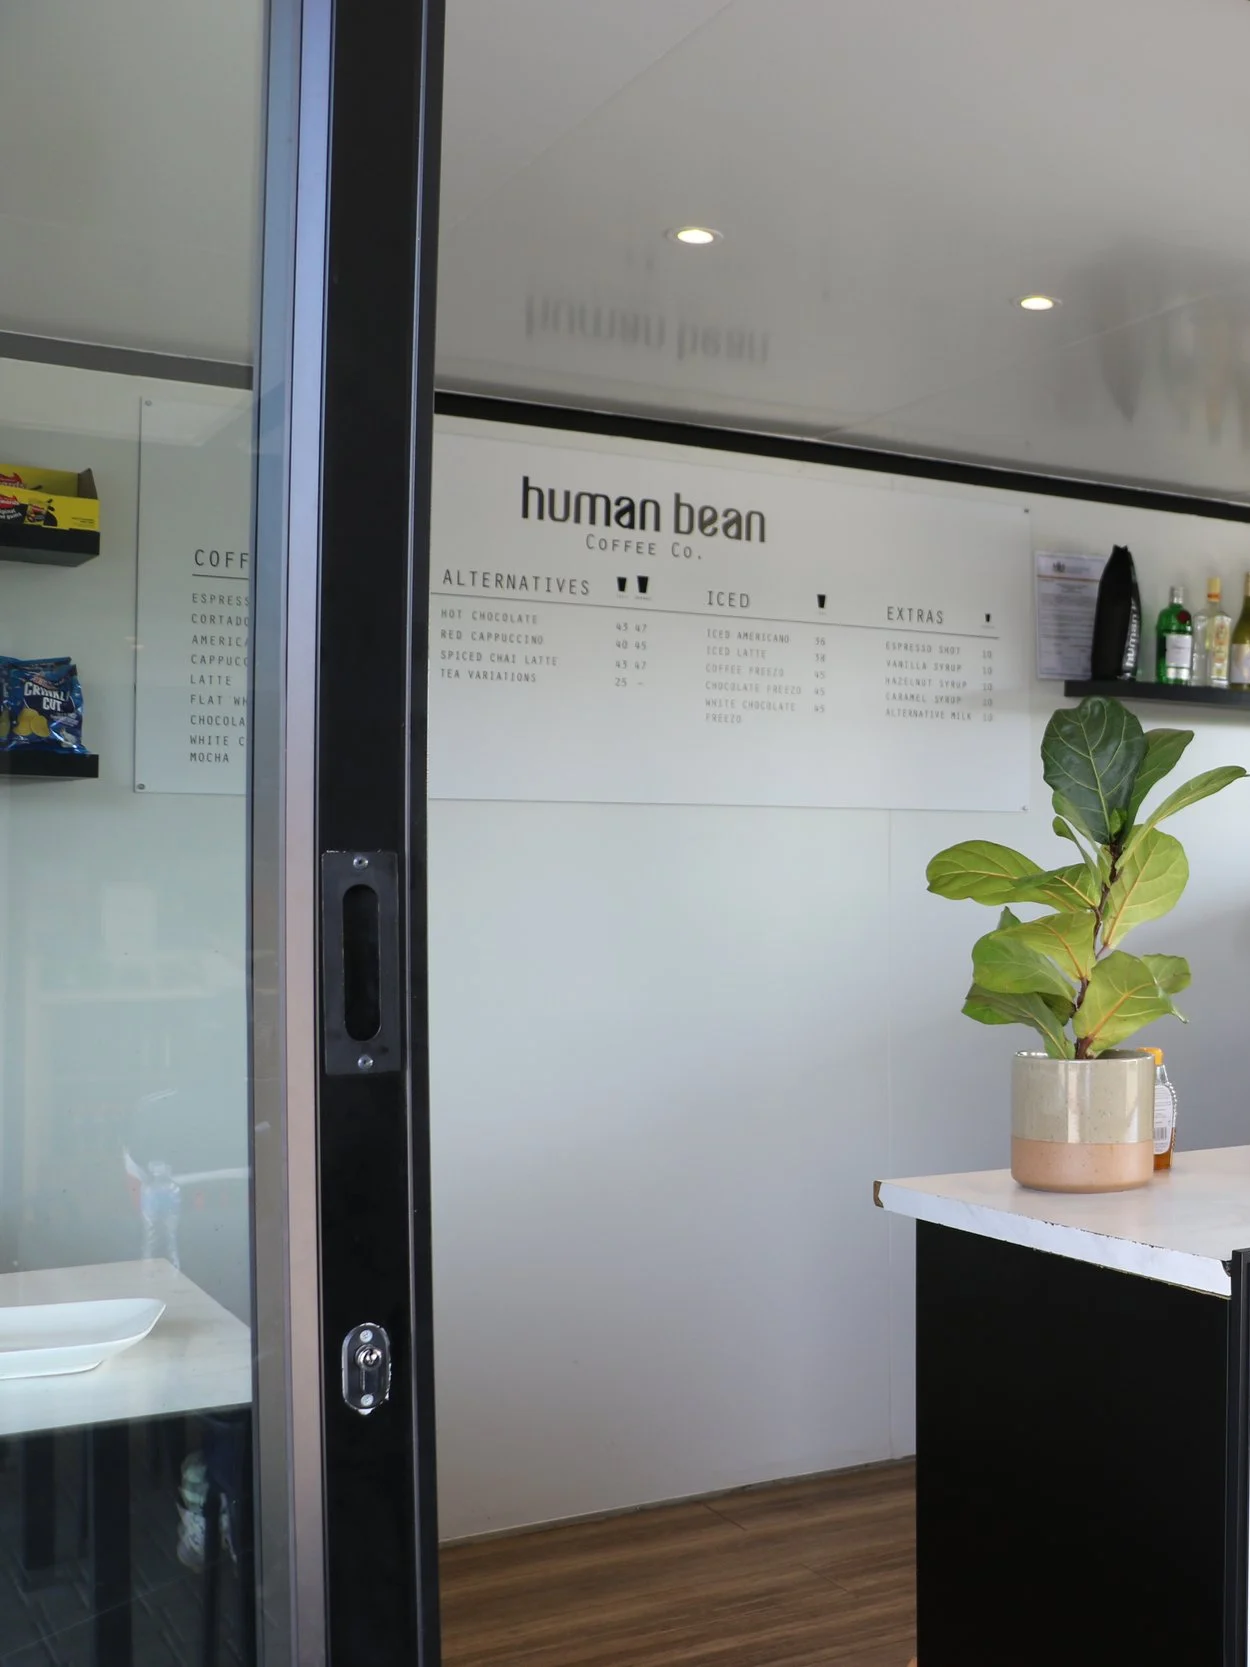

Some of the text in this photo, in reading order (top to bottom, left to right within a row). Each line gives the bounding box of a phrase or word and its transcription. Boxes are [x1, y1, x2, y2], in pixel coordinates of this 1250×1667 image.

[521, 476, 766, 543] human bean
[443, 569, 589, 595] ALTERNATIVES
[707, 590, 750, 608] ICED
[441, 609, 462, 619] HOT
[472, 611, 538, 624] CHOCOLATE
[887, 606, 943, 624] EXTRAS
[440, 629, 462, 640] RED
[471, 631, 544, 645] CAPPUCCINO
[707, 628, 730, 639] ICED
[737, 631, 790, 644] AMERICANO
[707, 646, 730, 656] ICED
[737, 648, 767, 660] LATTE
[886, 641, 932, 654] ESPRESSO
[938, 645, 960, 655] SHOT
[440, 650, 482, 661] SPICED
[490, 652, 516, 664] CHAI
[525, 655, 557, 667] LATTE
[190, 674, 231, 686] LATTE
[441, 668, 460, 679] TEA
[468, 670, 536, 683] VARIATIONS
[705, 681, 760, 693] CHOCOLATE
[42, 696, 62, 712] CUT
[190, 694, 222, 705] FLAT
[742, 699, 796, 712] CHOCOLATE
[189, 735, 229, 746] WHITE
[190, 752, 229, 763] MOCHA
